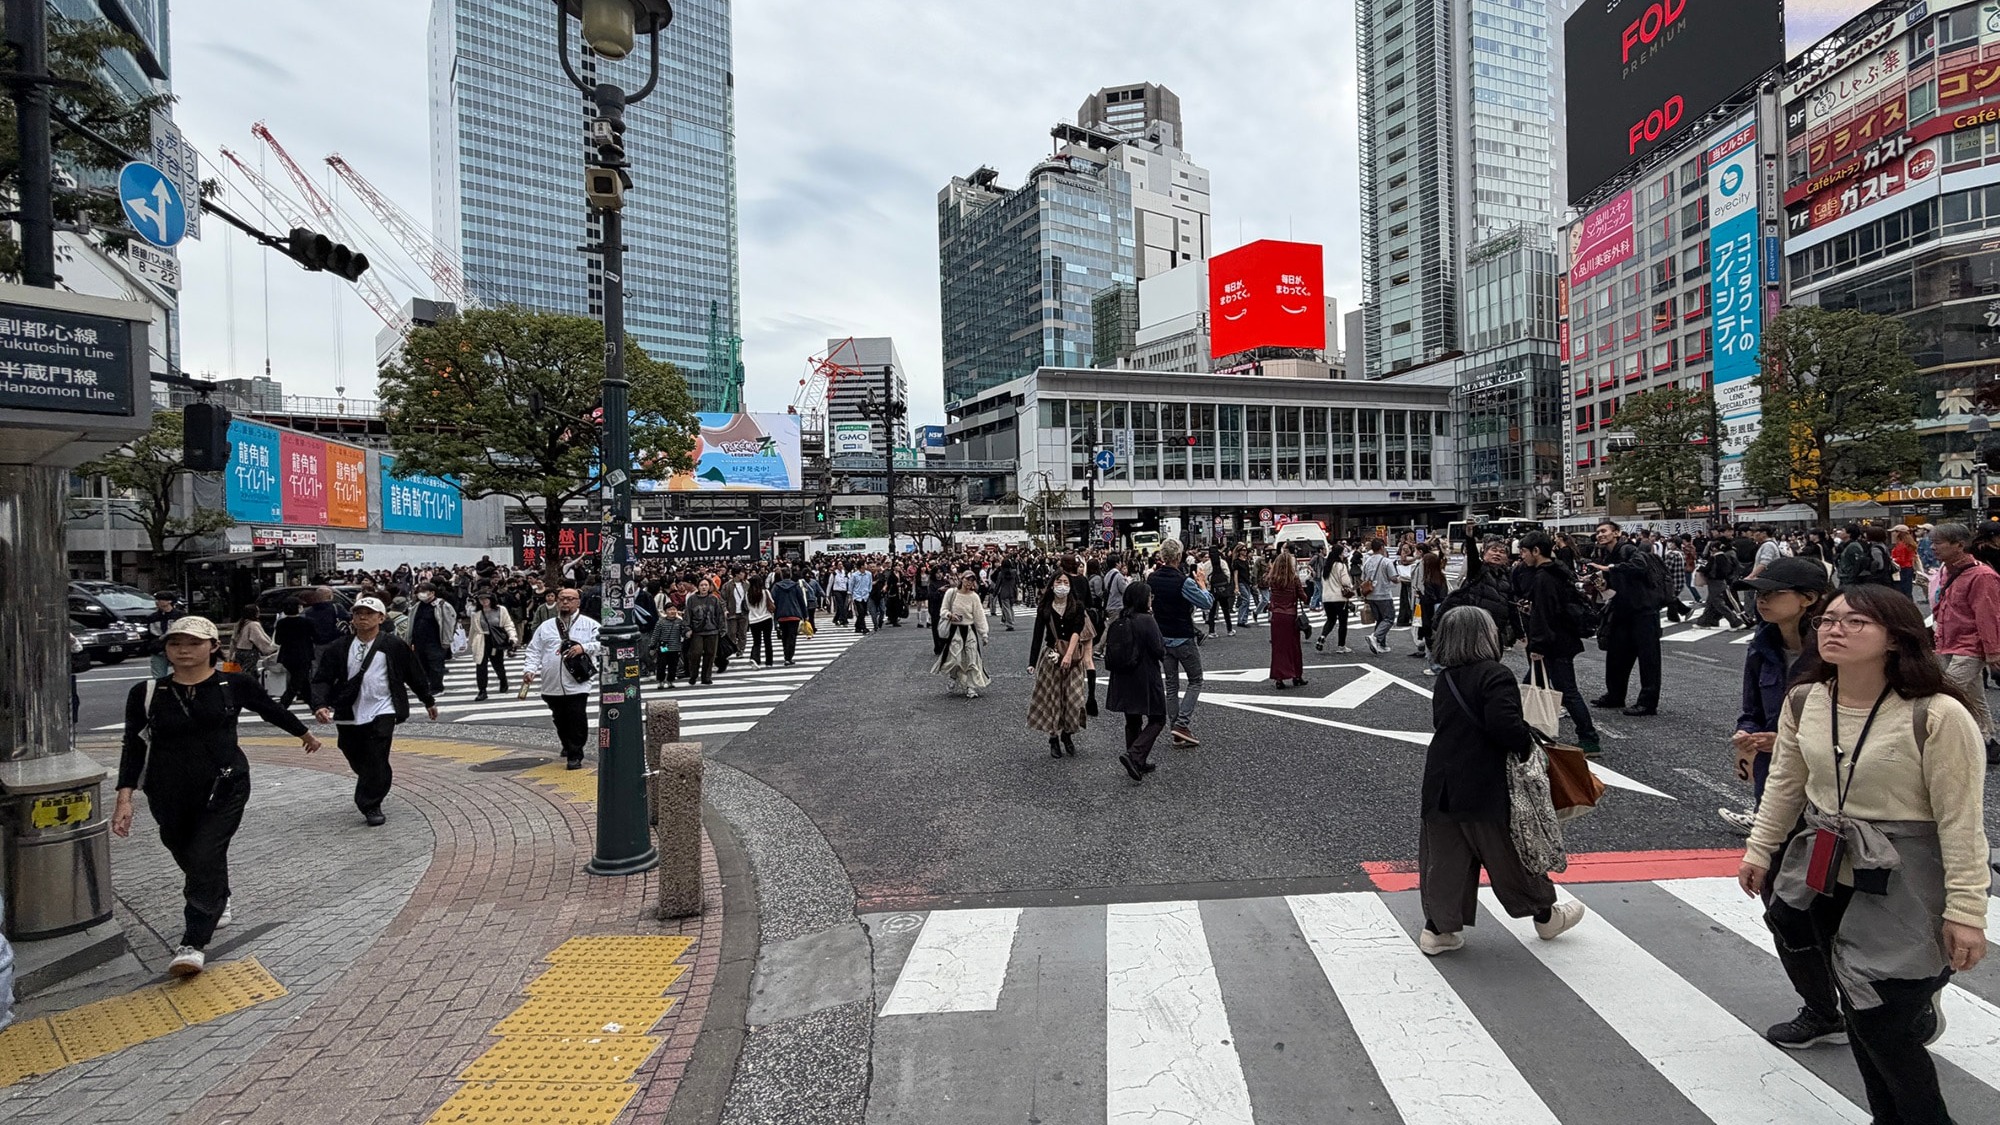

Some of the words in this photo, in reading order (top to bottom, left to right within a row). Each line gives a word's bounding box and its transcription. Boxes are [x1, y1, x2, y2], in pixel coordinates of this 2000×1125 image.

[1622, 0, 1687, 64] FOD
[1623, 18, 1686, 80] PREMIUM
[1840, 49, 1900, 99] しゃぶ葉
[1629, 94, 1684, 155] FOD
[1789, 108, 1805, 128] 9F
[1953, 107, 2000, 129] Café
[1712, 128, 1751, 161] 当ビル5F
[1811, 101, 1905, 165] プライス
[1864, 135, 1913, 173] ガスト
[1714, 191, 1751, 217] eyecity
[1840, 171, 1899, 216] ガスト
[1594, 212, 1626, 238] クリニック
[1595, 199, 1630, 227] 品川スキン
[1790, 210, 1810, 230] 7F
[1578, 238, 1631, 278] 品川美容外科
[1275, 285, 1311, 297] まわってく。
[1281, 274, 1305, 286] 毎日が、
[1737, 232, 1755, 351] コンタクトの
[1220, 289, 1251, 306] まわってく。
[1715, 240, 1737, 356] アイシティ
[0, 318, 98, 345] 副都心線
[0, 336, 80, 356] ukutoshin
[84, 346, 115, 360] Line
[0, 361, 98, 386] 半蔵門線
[1461, 379, 1493, 393] MARK
[1497, 370, 1527, 383] CITY
[85, 387, 115, 401] Line
[1723, 383, 1750, 395] CONTACT
[1729, 392, 1744, 401] LENS
[839, 433, 867, 441] GMO
[238, 441, 270, 468] 龍角散
[291, 452, 318, 475] 龍角散
[234, 466, 276, 493] ダイレクト
[335, 461, 358, 482] 龍角散
[288, 474, 323, 498] ダイレクト
[333, 481, 362, 502] ダイレクト
[1899, 484, 1998, 500] L'OCCITN
